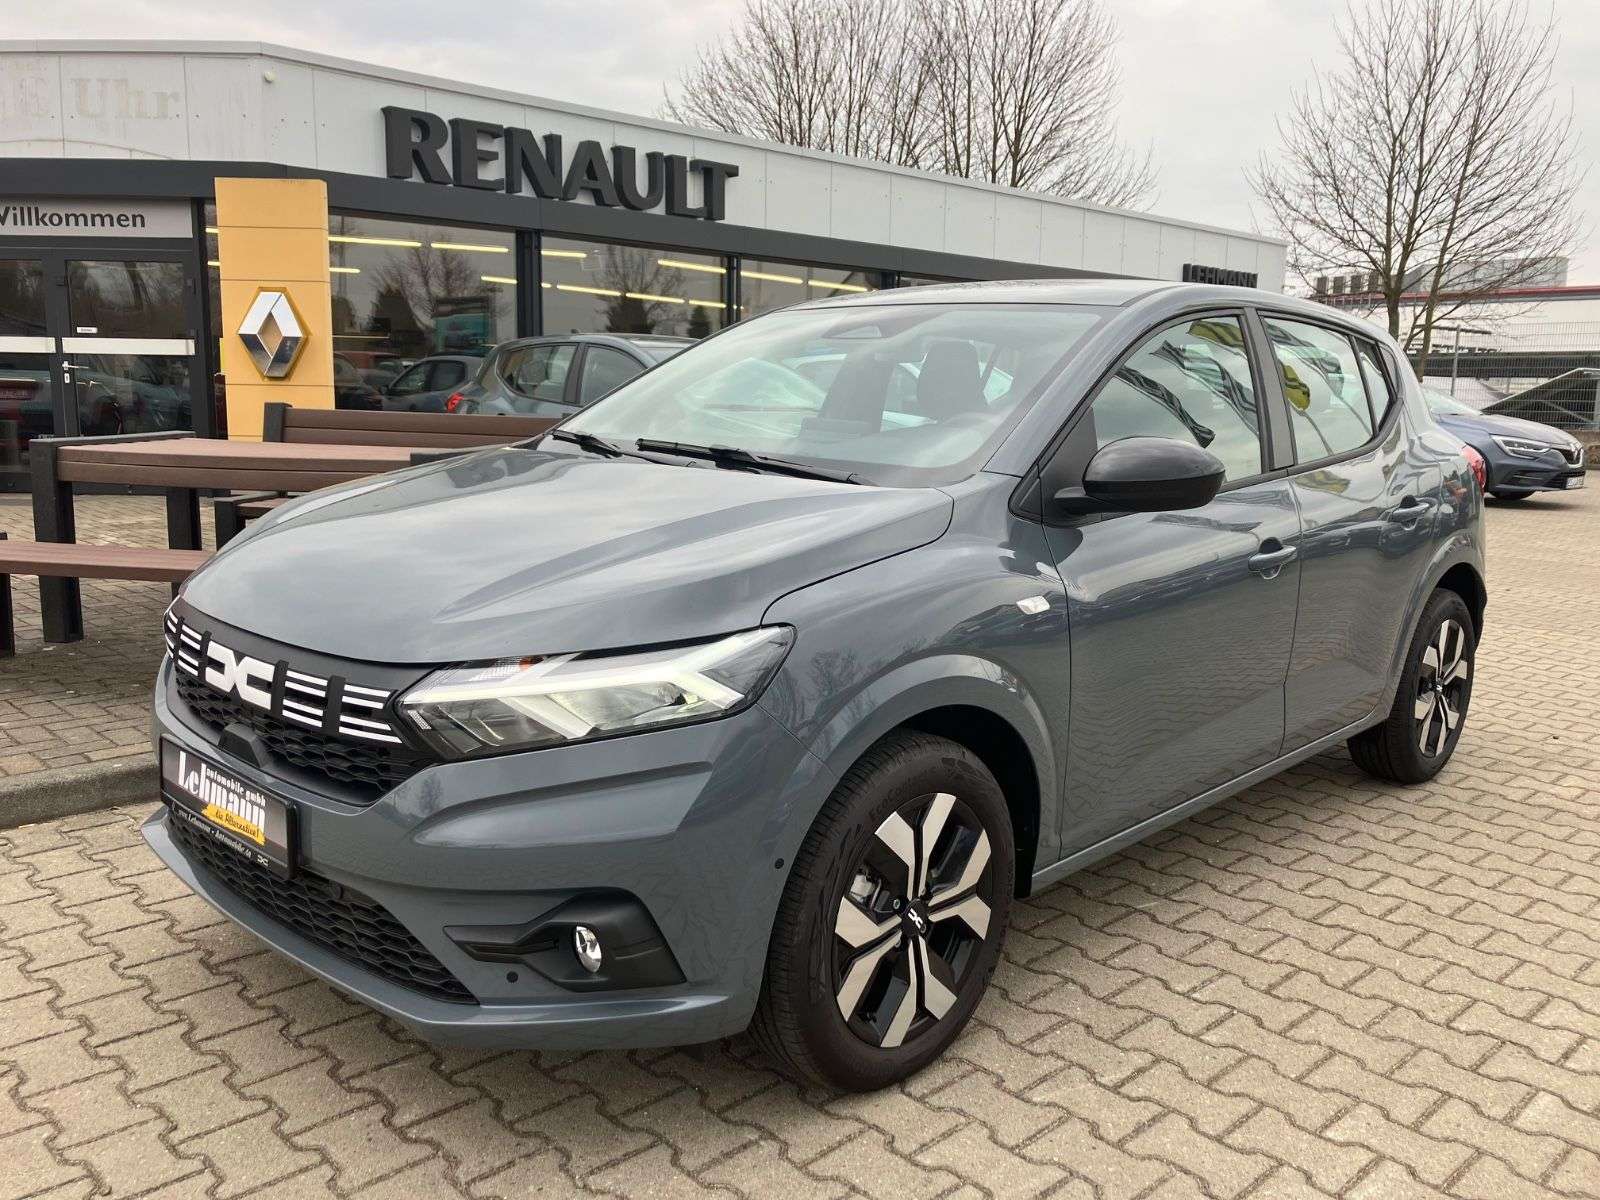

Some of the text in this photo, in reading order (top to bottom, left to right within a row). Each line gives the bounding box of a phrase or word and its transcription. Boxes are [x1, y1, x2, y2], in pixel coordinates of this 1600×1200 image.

[381, 105, 740, 221] RENAULT
[1182, 263, 1258, 288] LEHMANN
[178, 750, 266, 833] Lehmann
